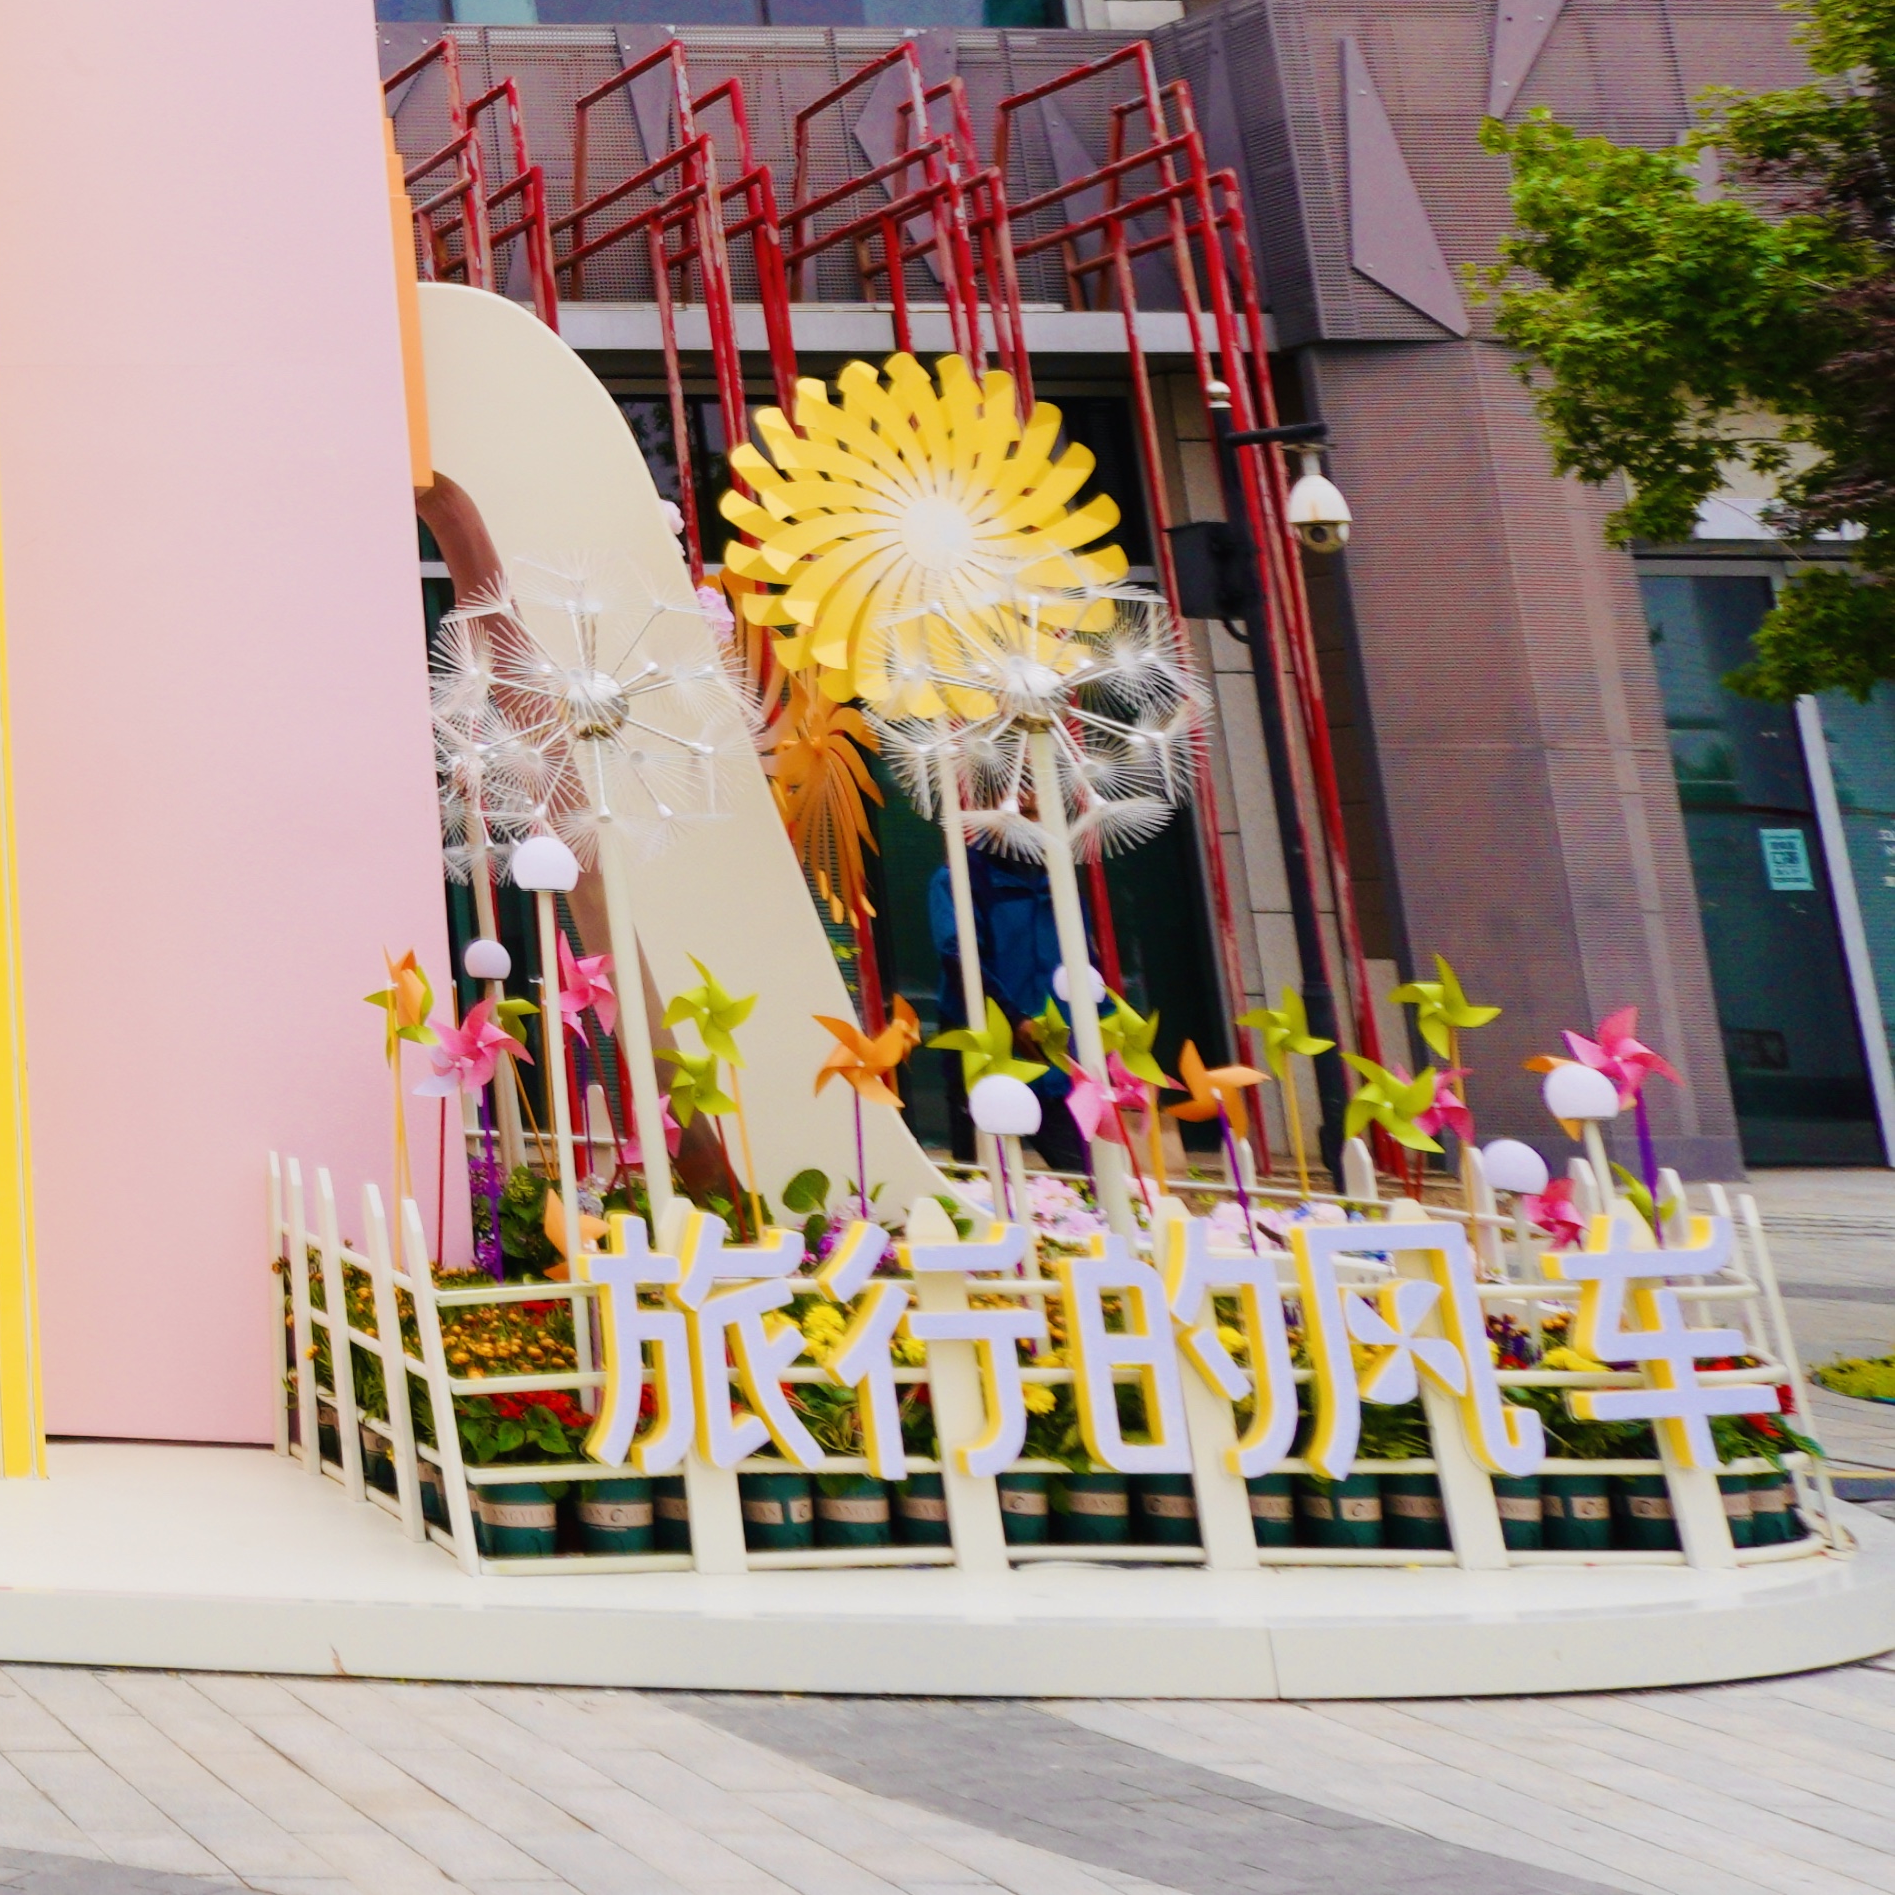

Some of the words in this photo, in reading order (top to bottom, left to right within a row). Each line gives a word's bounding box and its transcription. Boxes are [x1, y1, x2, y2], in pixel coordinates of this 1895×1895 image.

[578, 1211, 1779, 1482] 旅行的风车
